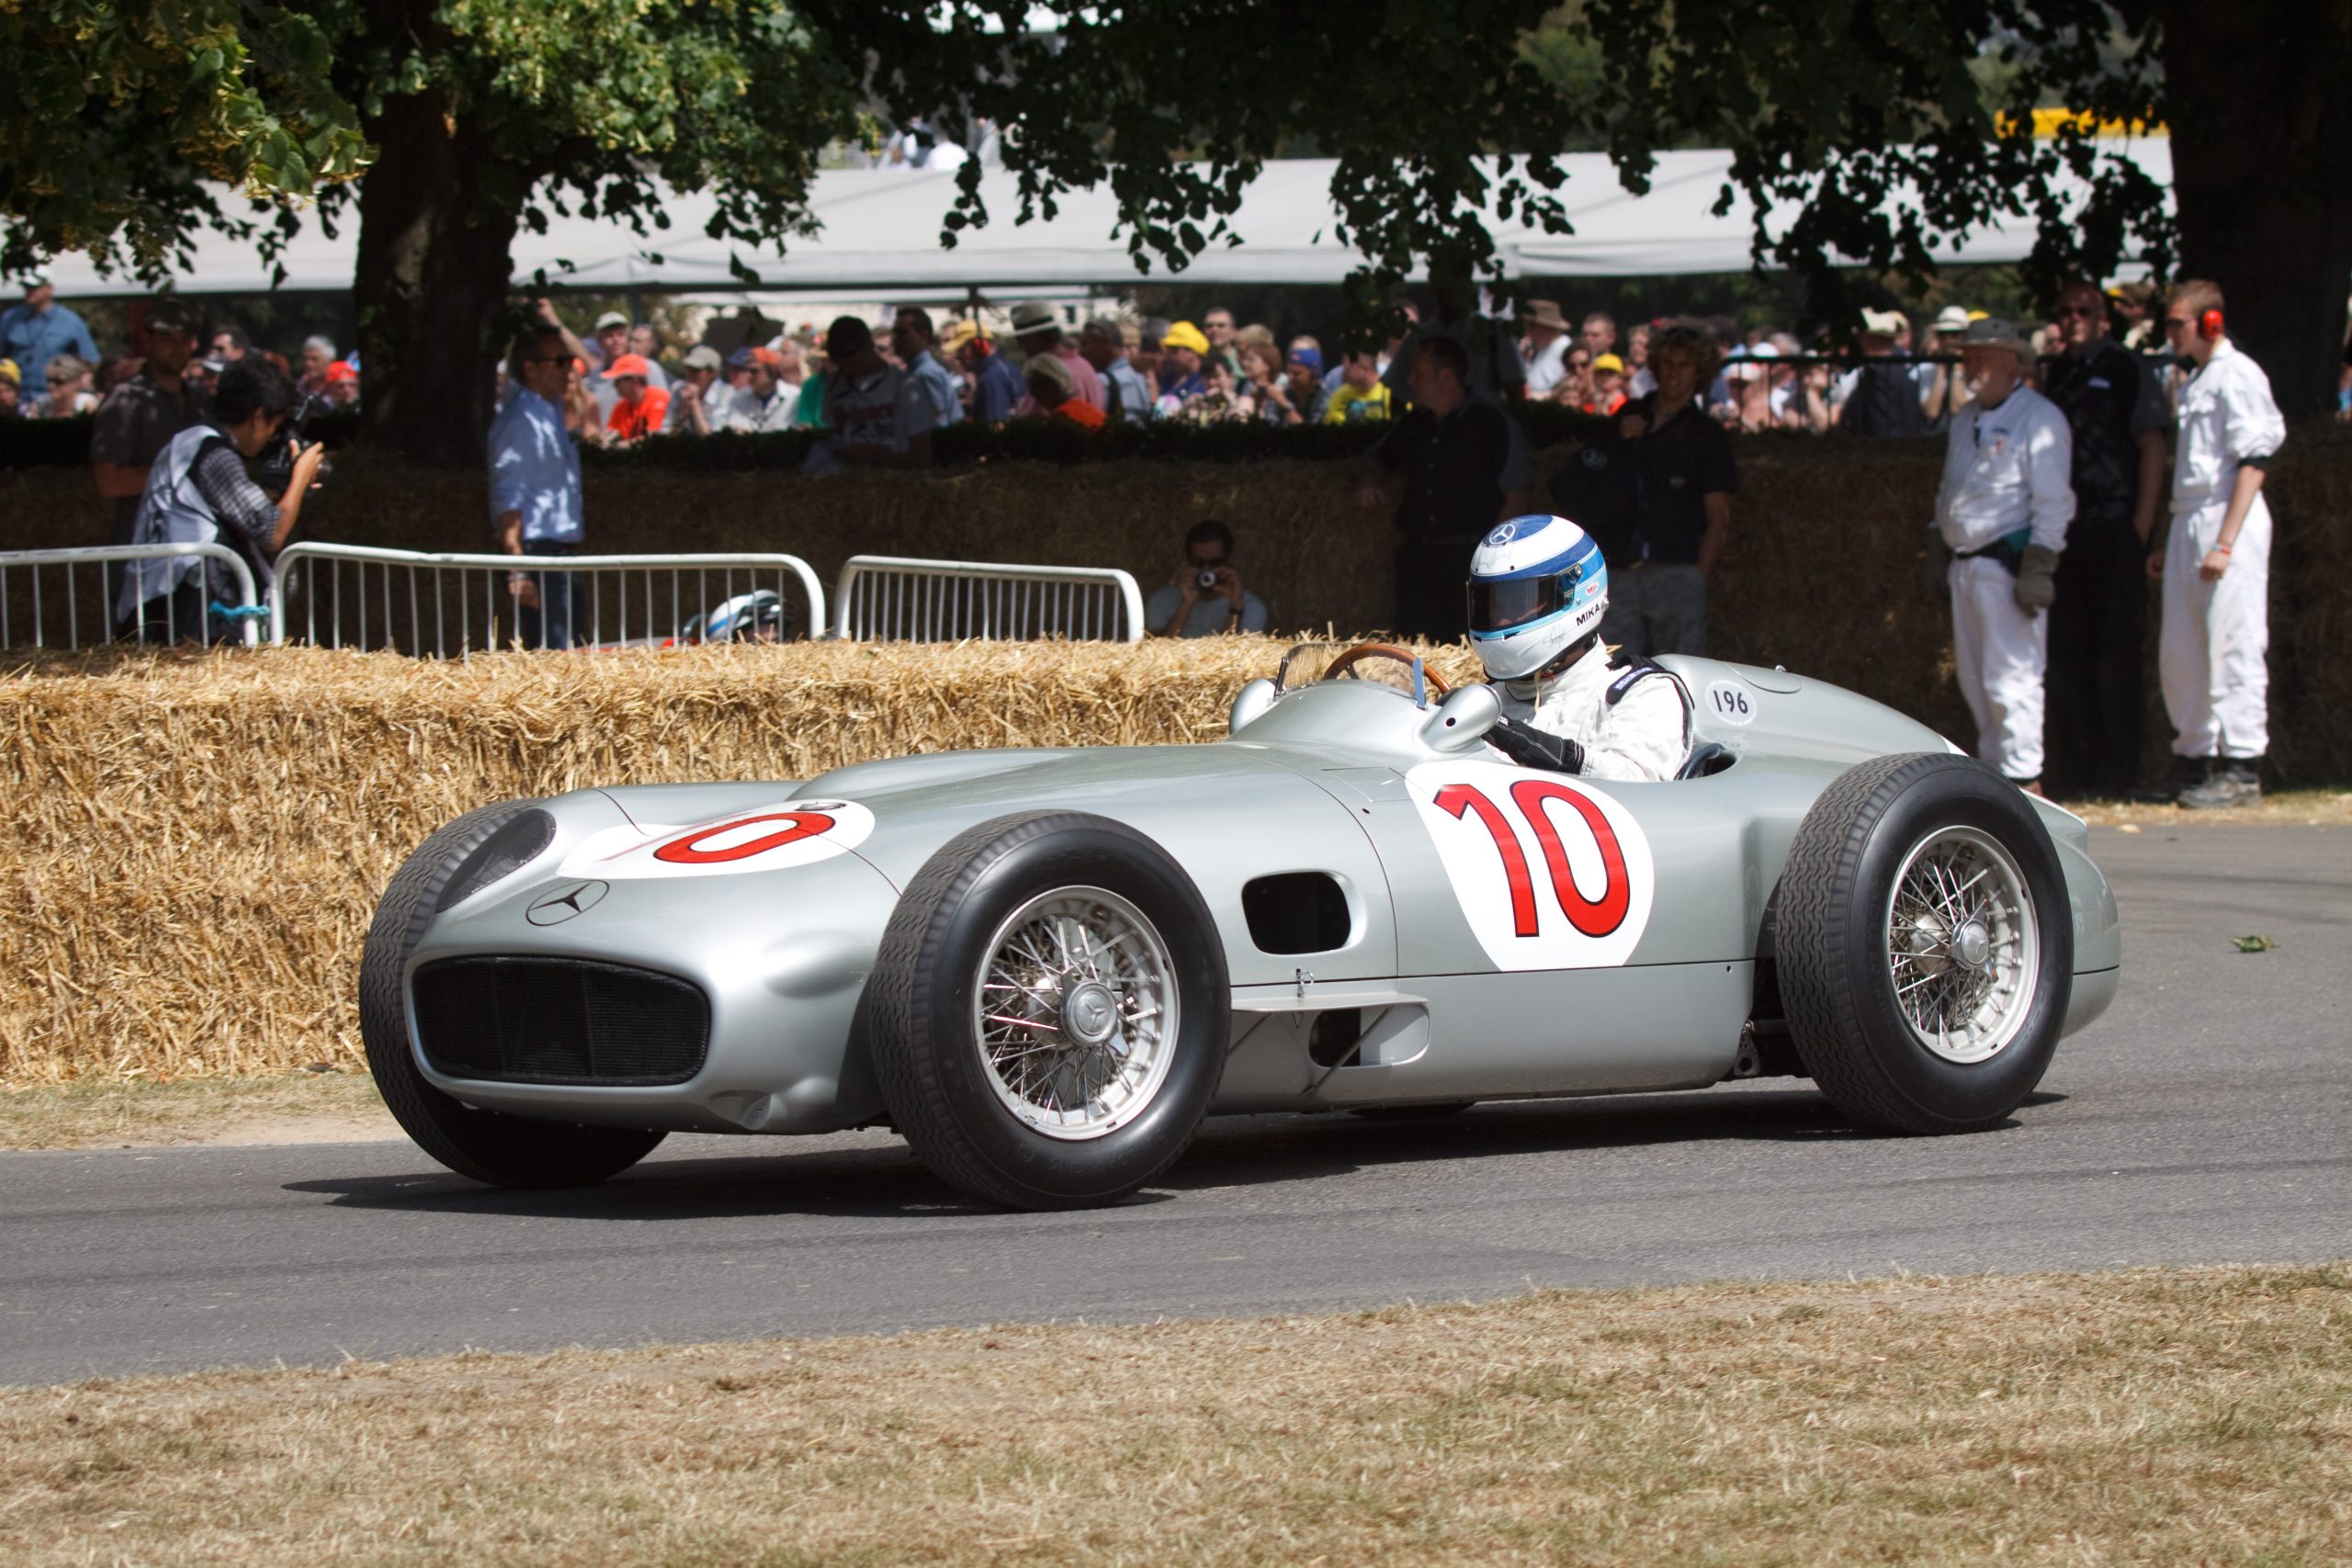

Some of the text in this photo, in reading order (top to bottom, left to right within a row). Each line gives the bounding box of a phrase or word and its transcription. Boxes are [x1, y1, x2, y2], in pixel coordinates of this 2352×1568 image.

[1576, 604, 1600, 626] MIKA
[1713, 690, 1748, 715] 196
[1432, 779, 1631, 938] 10
